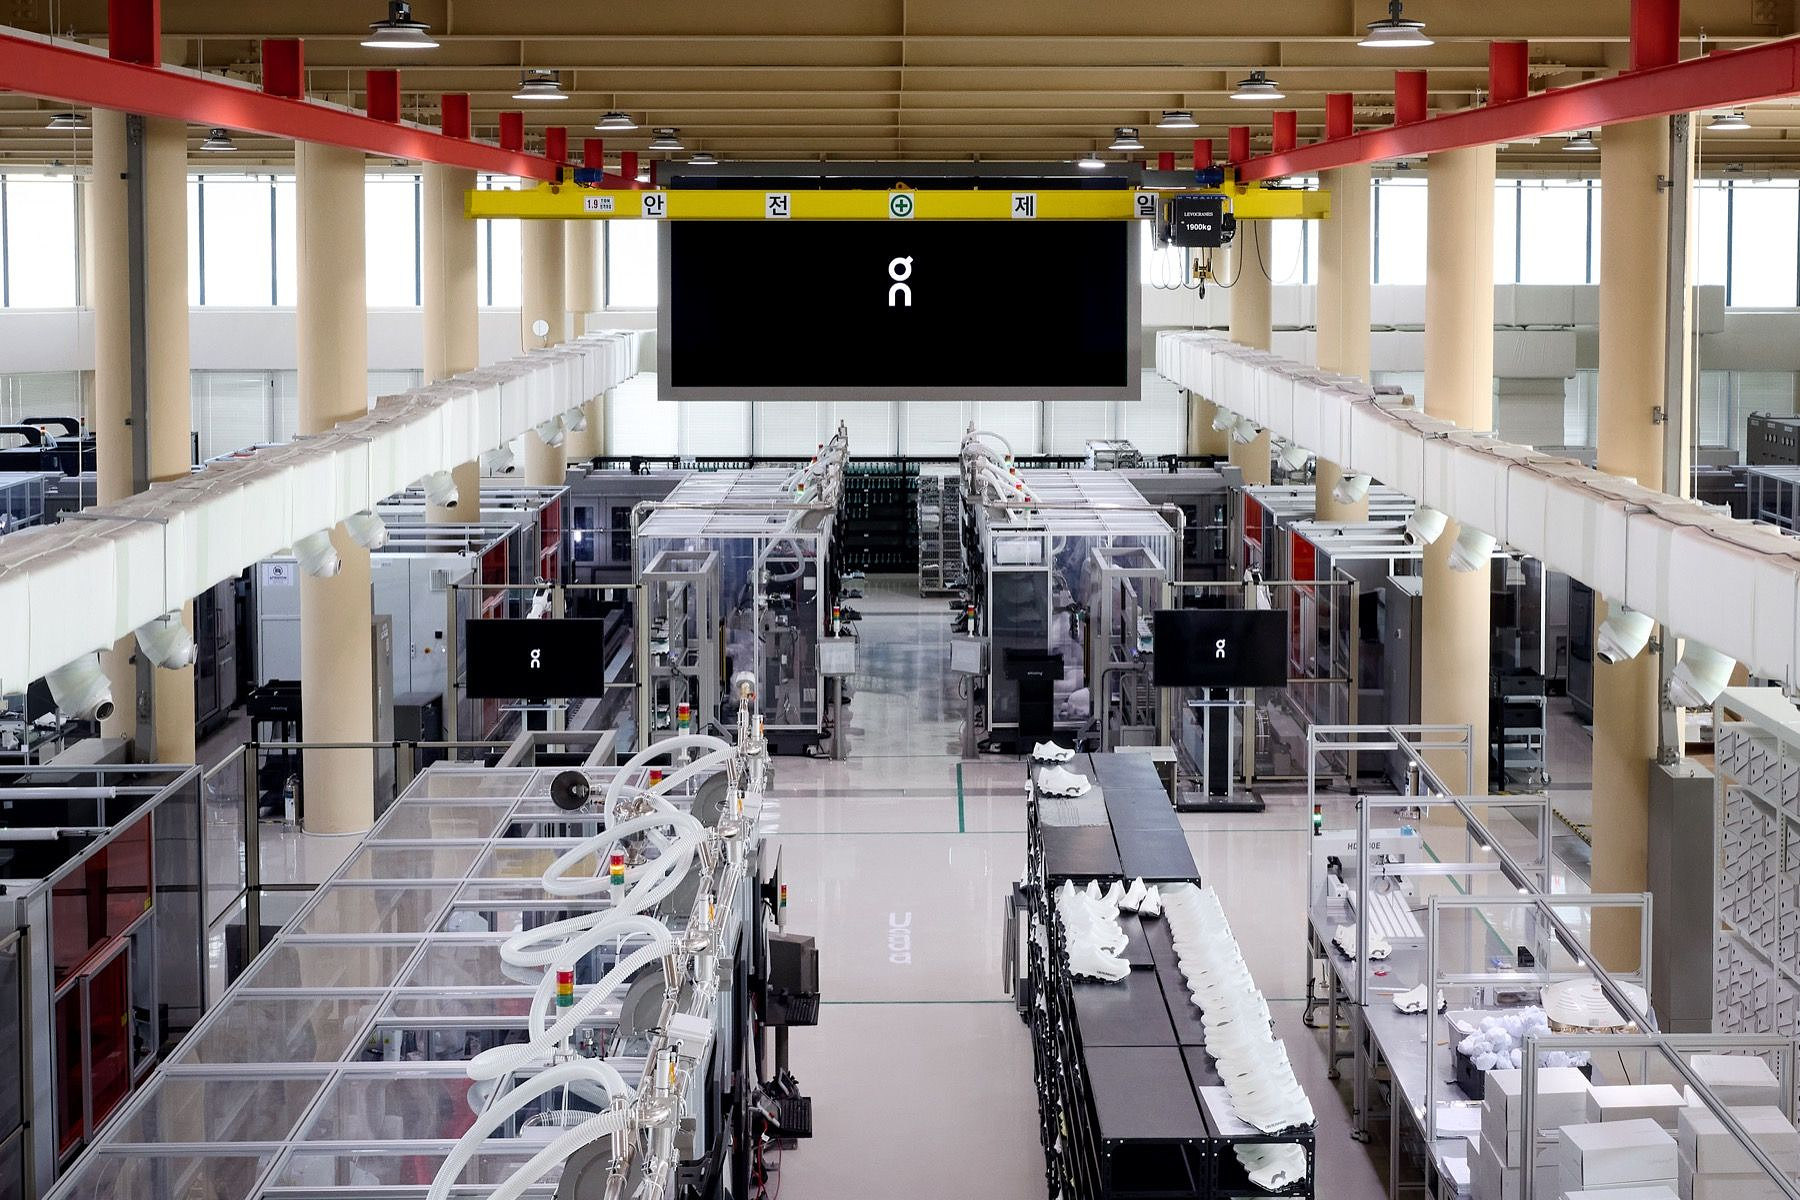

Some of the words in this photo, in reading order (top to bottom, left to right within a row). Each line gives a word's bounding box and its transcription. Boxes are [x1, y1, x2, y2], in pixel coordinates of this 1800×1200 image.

[587, 199, 599, 209] 1.9
[644, 195, 665, 216] 안
[769, 196, 787, 215] 전
[1015, 196, 1034, 217] 제
[1186, 223, 1212, 231] 1900kg
